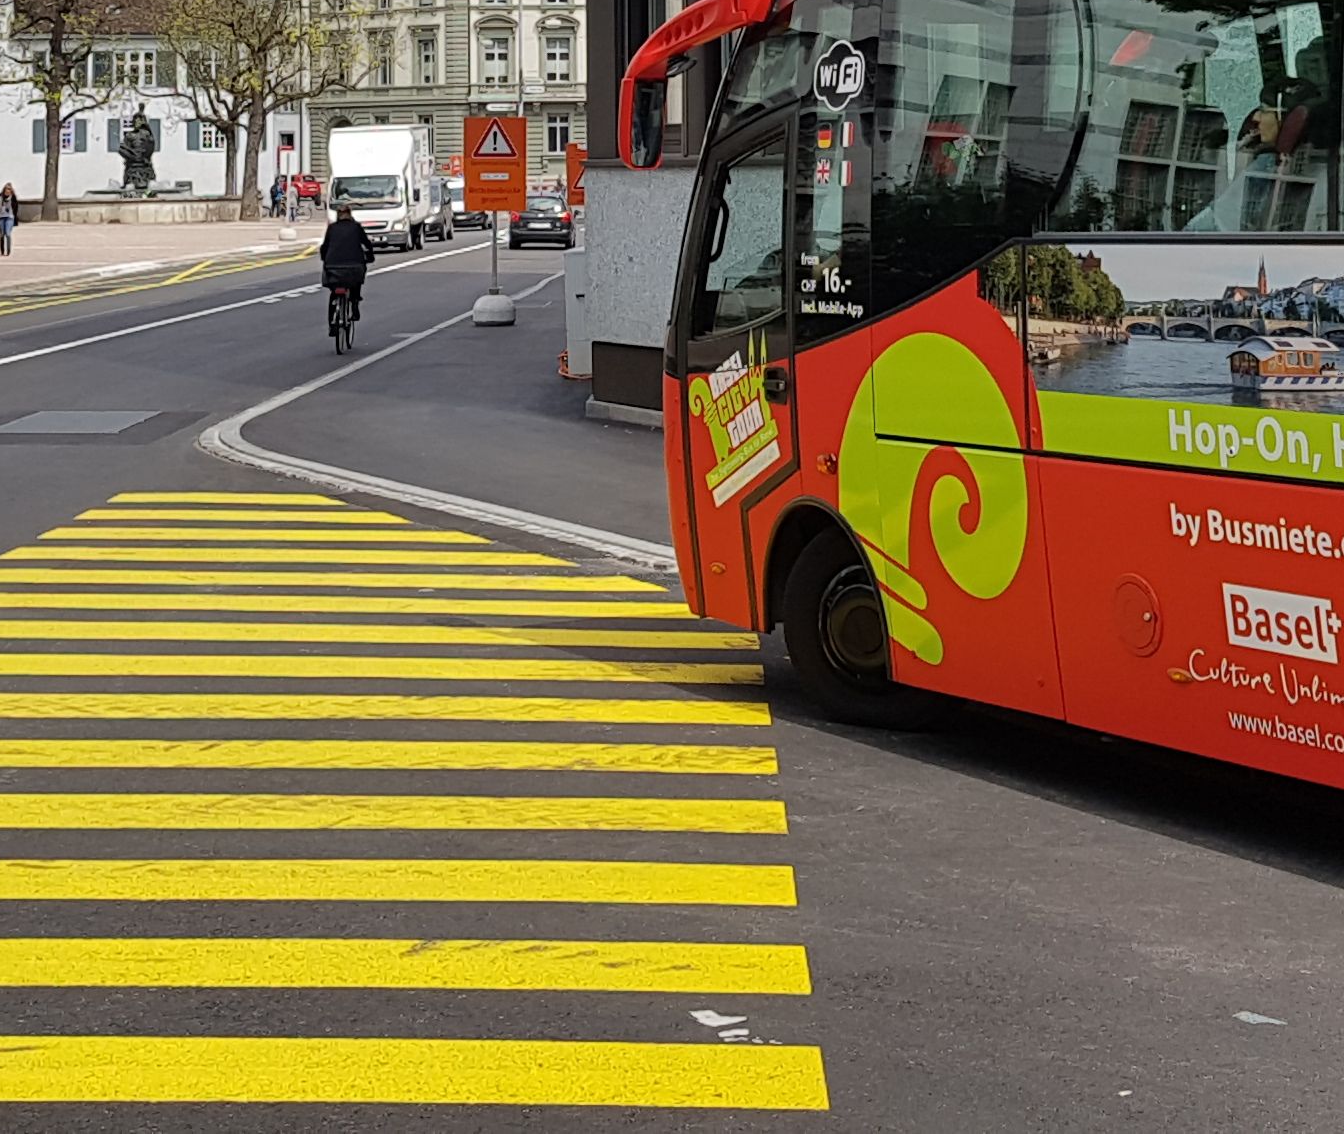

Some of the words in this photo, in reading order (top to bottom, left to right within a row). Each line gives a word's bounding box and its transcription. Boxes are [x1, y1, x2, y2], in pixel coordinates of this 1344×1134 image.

[822, 267, 852, 293] 16.-
[1168, 408, 1322, 473] Hop-On,
[1169, 502, 1202, 547] by
[1188, 648, 1276, 695] Culture
